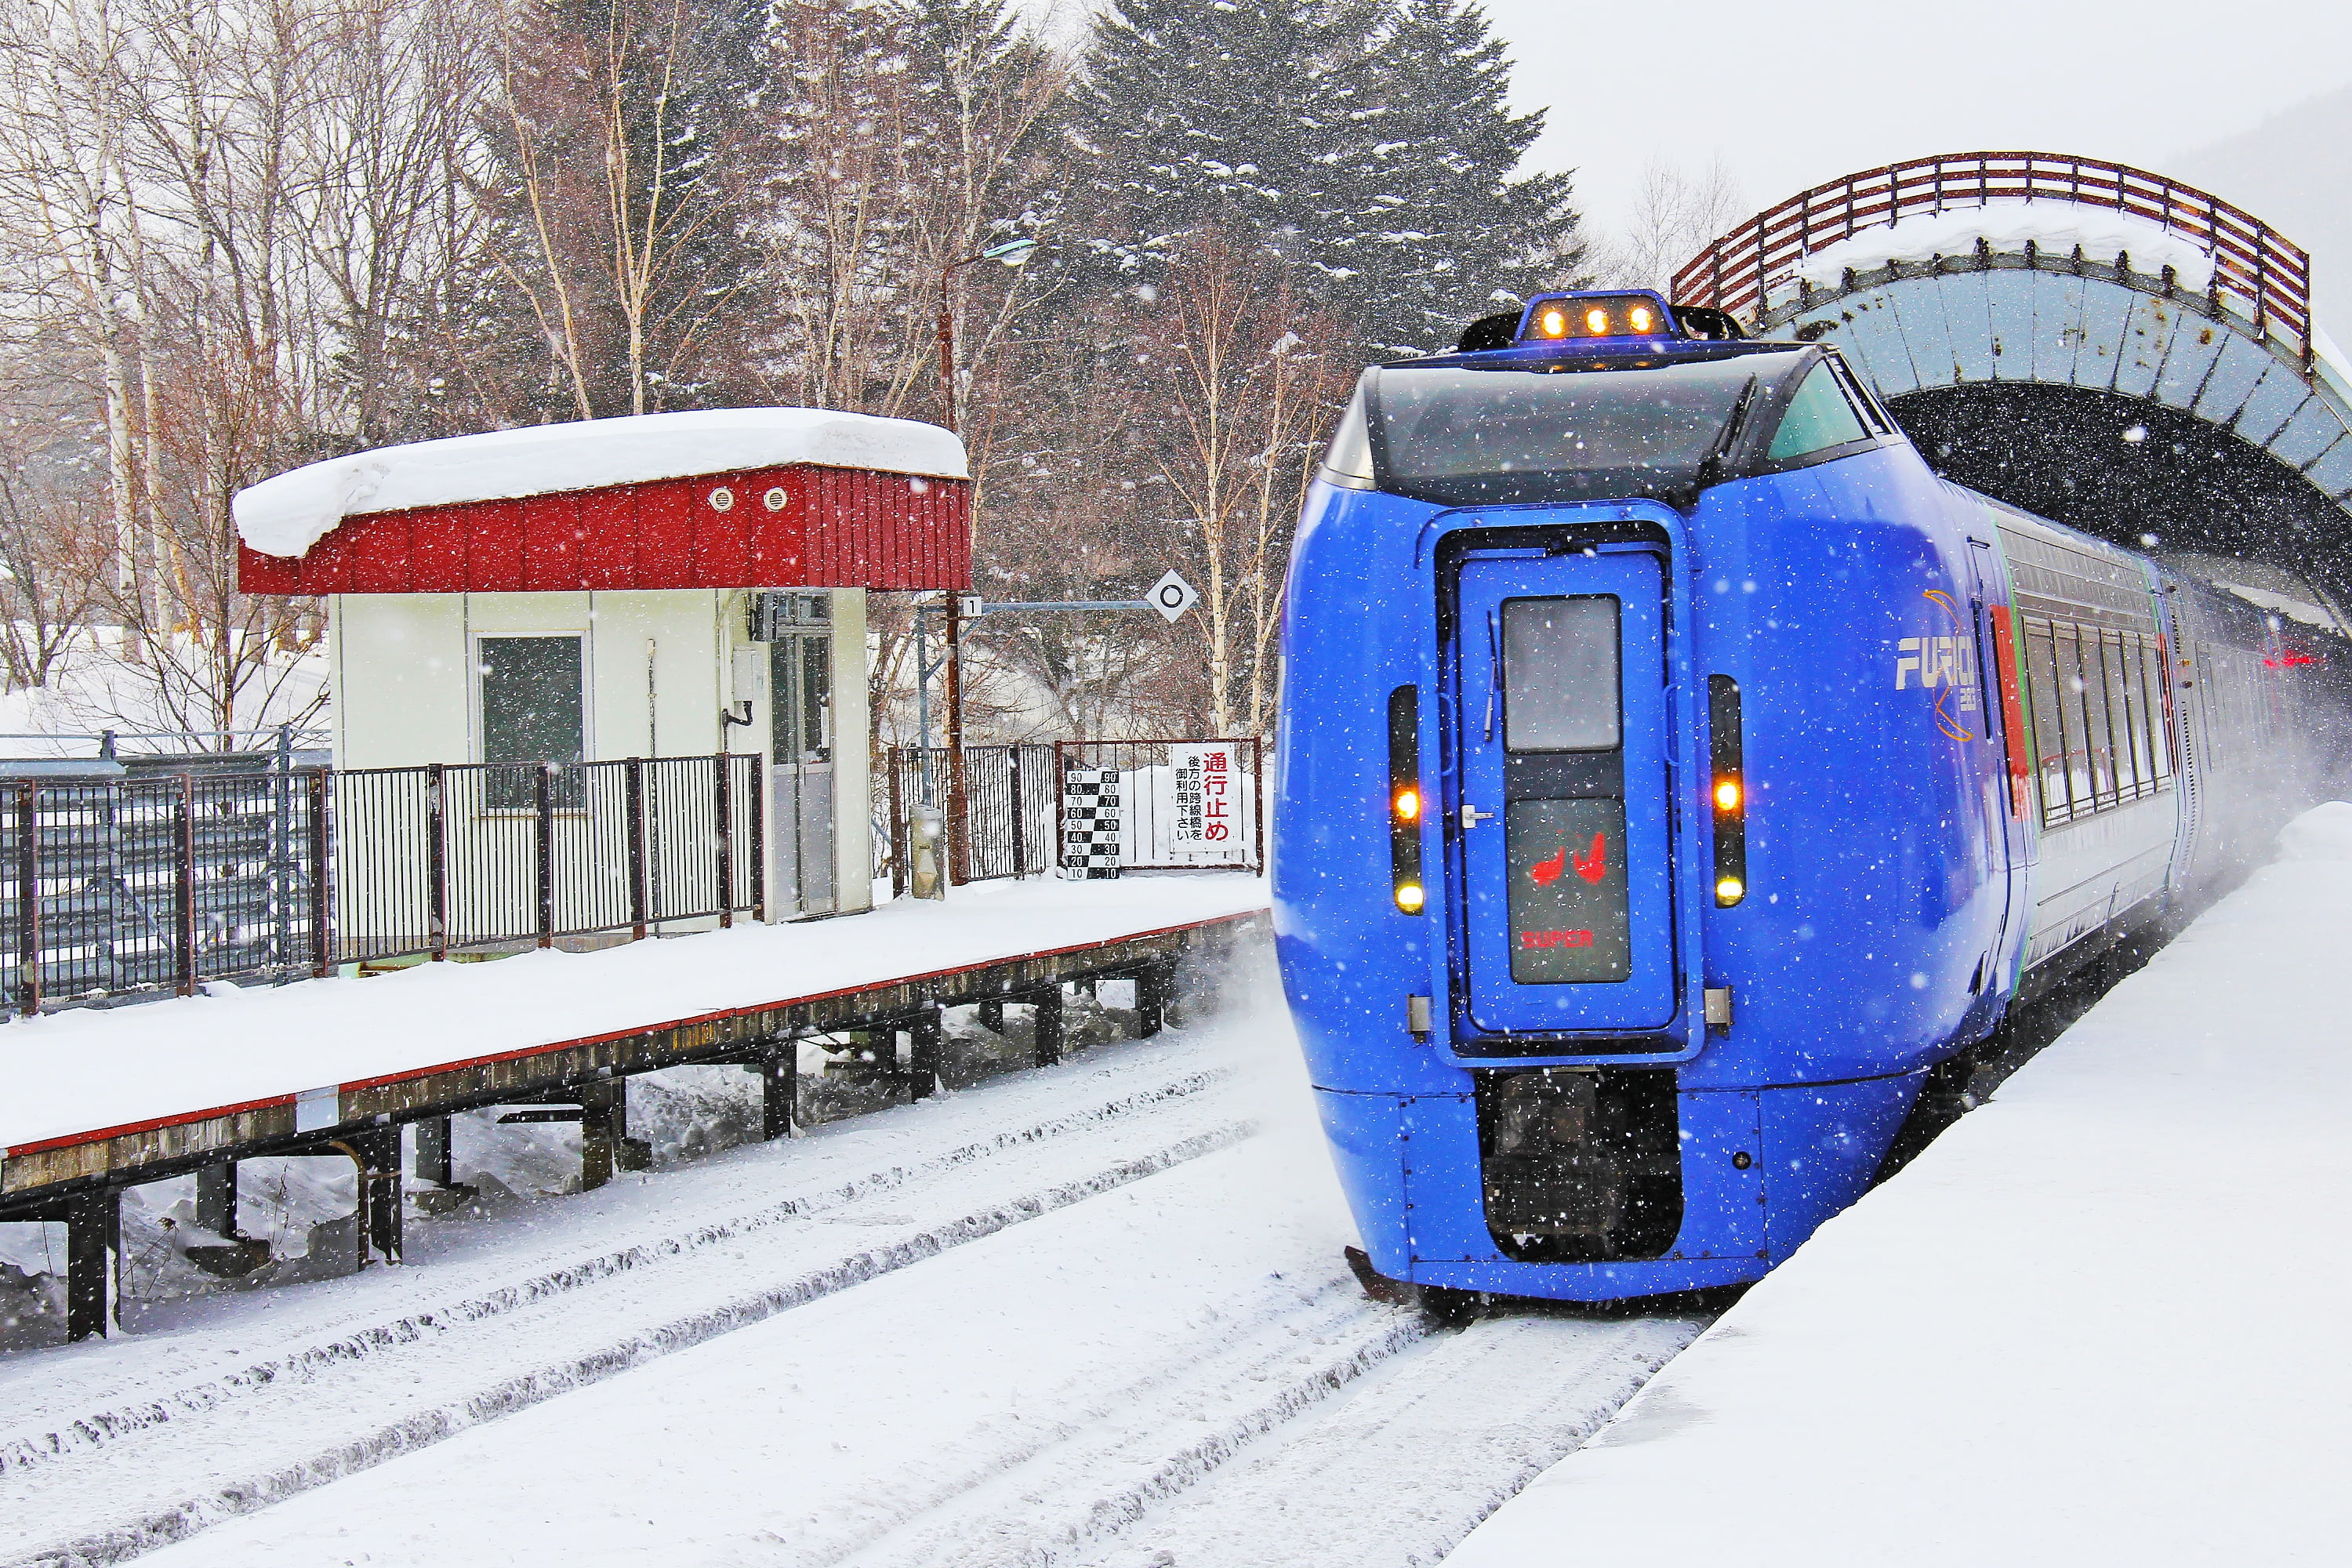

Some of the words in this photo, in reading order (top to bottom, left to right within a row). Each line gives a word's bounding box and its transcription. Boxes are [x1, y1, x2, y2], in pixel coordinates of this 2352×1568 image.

[969, 600, 975, 614] 1
[1071, 772, 1082, 782] 90
[1104, 772, 1116, 782] 90
[1071, 784, 1082, 793] 80
[1071, 797, 1082, 806] 70
[1104, 796, 1116, 806] 70
[1188, 755, 1202, 840] 後方の跨線橋を
[1203, 752, 1229, 841] 通行止め
[1175, 768, 1189, 840] 御利用下さい
[1071, 808, 1082, 818] 60
[1104, 808, 1116, 818] 60
[1071, 820, 1082, 829] 50
[1104, 820, 1116, 829] 50
[1071, 833, 1082, 842] 40
[1104, 833, 1116, 842] 40
[1071, 845, 1082, 854] 30
[1104, 844, 1116, 854] 30
[1071, 857, 1082, 866] 20
[1104, 857, 1116, 866] 20
[1071, 869, 1082, 878] 10
[1104, 869, 1116, 878] 10
[1521, 930, 1593, 949] SUPER
